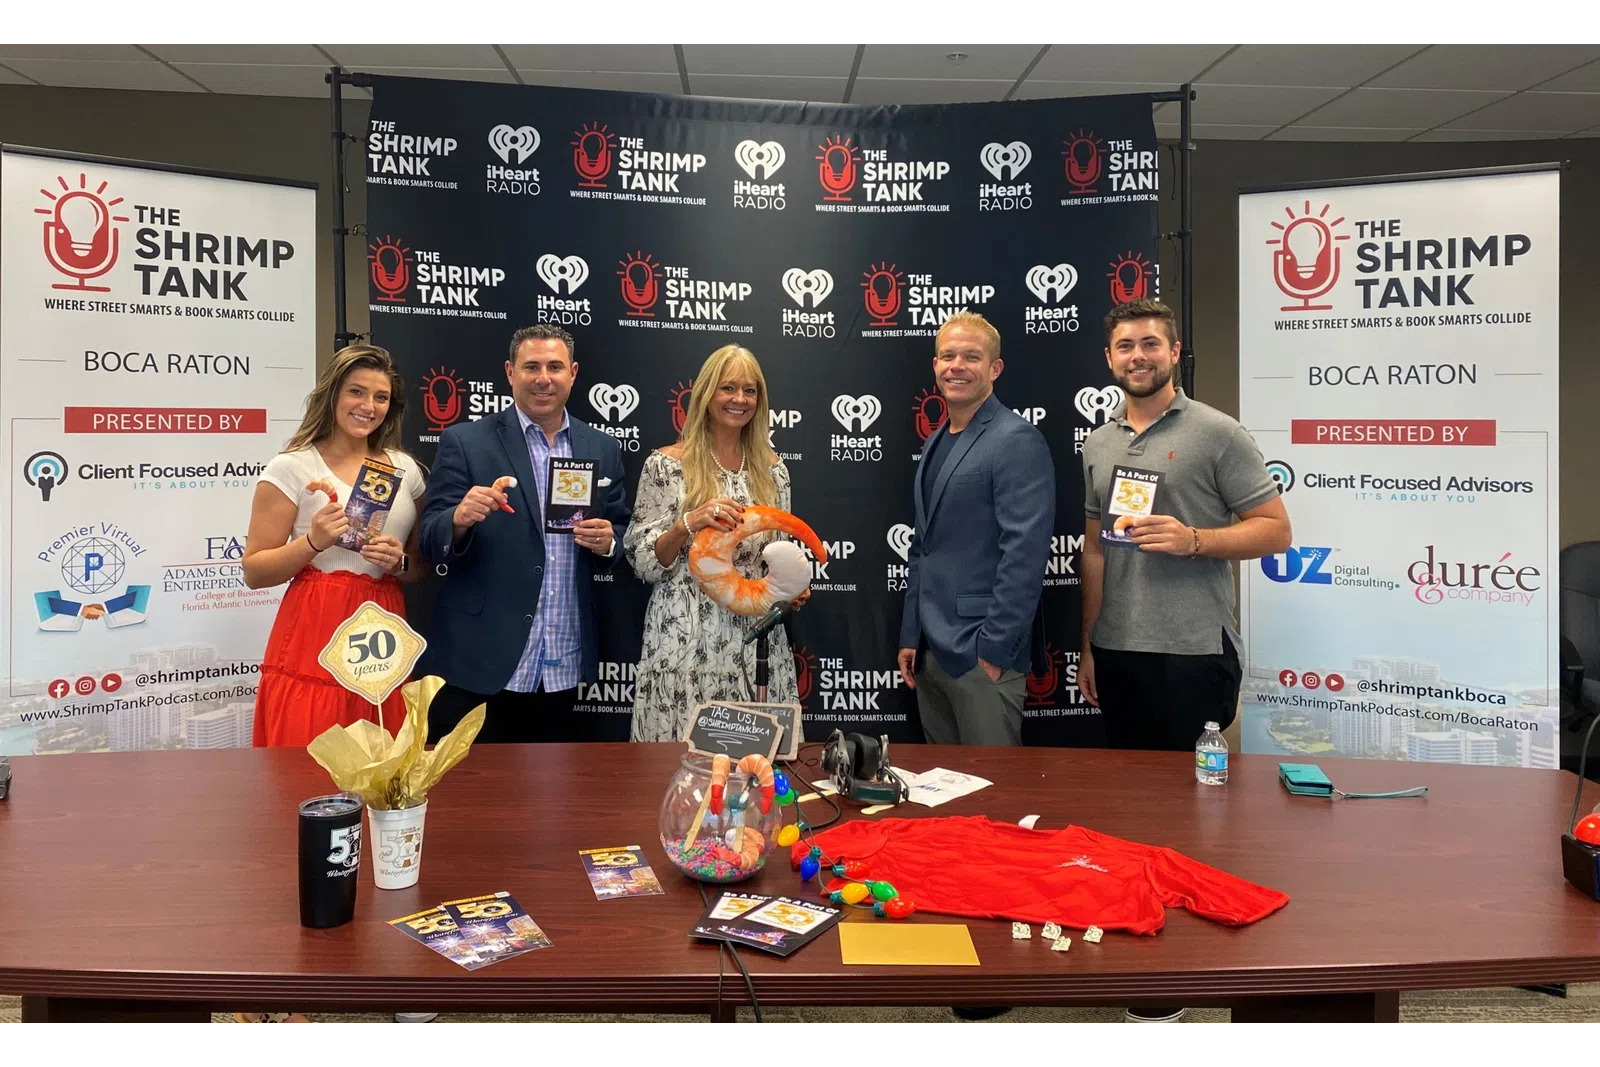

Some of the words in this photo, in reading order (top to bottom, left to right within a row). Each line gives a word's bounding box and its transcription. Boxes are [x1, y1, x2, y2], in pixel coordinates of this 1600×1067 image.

[371, 120, 395, 132] THE
[369, 133, 458, 156] SHRIMP
[620, 137, 644, 149] THE
[1108, 140, 1133, 151] THE
[619, 150, 706, 173] SHRIMP
[863, 150, 887, 161] THE
[369, 154, 431, 176] TANK
[487, 164, 539, 181] iHeart
[863, 162, 950, 181] SHRIMP
[487, 180, 541, 195] RADIO
[618, 171, 679, 192] TANK
[734, 180, 785, 197] iHeart
[980, 183, 1031, 197] iHeart
[570, 190, 590, 198] WHERE
[592, 192, 612, 200] STREET
[613, 193, 635, 201] SMARTS
[660, 196, 682, 204] SMARTS
[683, 197, 706, 205] COLLIDE
[863, 182, 923, 202] TANK
[734, 196, 786, 210] RADIO
[816, 204, 835, 212] WHERE
[837, 205, 857, 213] STREET
[858, 205, 880, 213] SMARTS
[881, 205, 886, 213] &
[927, 204, 950, 212] COLLIDE
[979, 197, 1032, 211] RADIO
[134, 205, 180, 226] THE
[1355, 219, 1400, 238] THE
[135, 228, 294, 269] SHRIMP
[415, 251, 440, 262] THE
[1356, 234, 1531, 273] SHRIMP
[417, 264, 505, 287] SHRIMP
[664, 266, 689, 278] THE
[908, 274, 932, 285] THE
[134, 264, 247, 301] TANK
[665, 279, 752, 301] SHRIMP
[417, 285, 479, 306] TANK
[909, 285, 995, 305] SHRIMP
[1355, 274, 1475, 309] TANK
[45, 298, 85, 310] WHERE
[88, 301, 126, 313] STREET
[130, 303, 172, 316] SMARTS
[175, 306, 182, 316] &
[186, 306, 213, 318] BOOK
[216, 308, 254, 320] SMARTS
[257, 310, 294, 322] COLLIDE
[538, 294, 590, 311] iHeart
[665, 300, 726, 321] TANK
[369, 304, 390, 313] WHERE
[391, 305, 412, 314] STREET
[413, 307, 436, 315] SMARTS
[437, 308, 441, 316] &
[443, 308, 459, 316] BOOK
[460, 310, 483, 318] SMARTS
[484, 311, 507, 319] COLLIDE
[537, 310, 592, 325] RADIO
[783, 309, 834, 324] iHeart
[1026, 305, 1078, 321] iHeart
[619, 319, 639, 328] WHERE
[661, 322, 684, 330] SMARTS
[690, 323, 706, 331] BOOK
[707, 324, 729, 332] SMARTS
[731, 325, 753, 333] COLLIDE
[1026, 319, 1079, 334] RADIO
[1275, 320, 1309, 330] WHERE
[1312, 318, 1348, 329] STREET
[1351, 317, 1392, 328] SMARTS
[1395, 317, 1403, 327] &
[1406, 315, 1435, 327] BOOK
[1438, 314, 1482, 326] SMARTS
[1486, 312, 1531, 324] COLLIDE
[782, 323, 835, 338] RADIO
[85, 351, 158, 372] BOCA
[168, 354, 250, 375] RATON
[1309, 366, 1378, 386] BOCA
[1389, 364, 1476, 385] RATON
[469, 381, 493, 393] THE
[93, 414, 212, 430] PRESENTED
[220, 415, 243, 430] BY
[831, 434, 882, 448] iHeart
[1317, 425, 1435, 442] PRESENTED
[1442, 426, 1468, 442] BY
[831, 449, 882, 461] RADIO
[78, 464, 134, 479] Client
[139, 462, 218, 478] Focused
[1134, 472, 1148, 480] Part
[556, 472, 587, 498] 50
[1304, 473, 1355, 489] Client
[1360, 474, 1440, 491] Focused
[1446, 476, 1533, 493] Advisors
[1116, 481, 1149, 510] 50
[1355, 492, 1382, 500] IT'S
[1391, 493, 1437, 502] ABOUT
[1447, 495, 1475, 503] YOU
[38, 525, 95, 562] Premier
[101, 522, 147, 558] Virtual
[163, 567, 216, 580] ADAMS
[1335, 565, 1369, 576] Digital
[1407, 545, 1540, 591] durée
[1334, 576, 1399, 590] Consulting.
[1415, 573, 1444, 604] &
[1448, 588, 1533, 606] company
[195, 591, 224, 601] College
[226, 591, 235, 599] of
[237, 589, 269, 598] Business
[182, 603, 209, 612] Florida
[211, 600, 242, 610] Atlantic
[244, 598, 280, 607] University
[347, 630, 396, 664] 50
[354, 661, 392, 680] years
[819, 658, 843, 669] THE
[820, 671, 904, 688] SHRIMP
[819, 692, 880, 710] TANK
[1357, 680, 1506, 705] @shrimptankboca
[710, 706, 730, 719] TAG
[737, 712, 756, 725] US!
[1257, 693, 1538, 731] www.ShrimpTankPodcast.com/BocaRaton
[456, 902, 512, 918] 50
[763, 904, 815, 926] 50
[801, 902, 824, 911] Part
